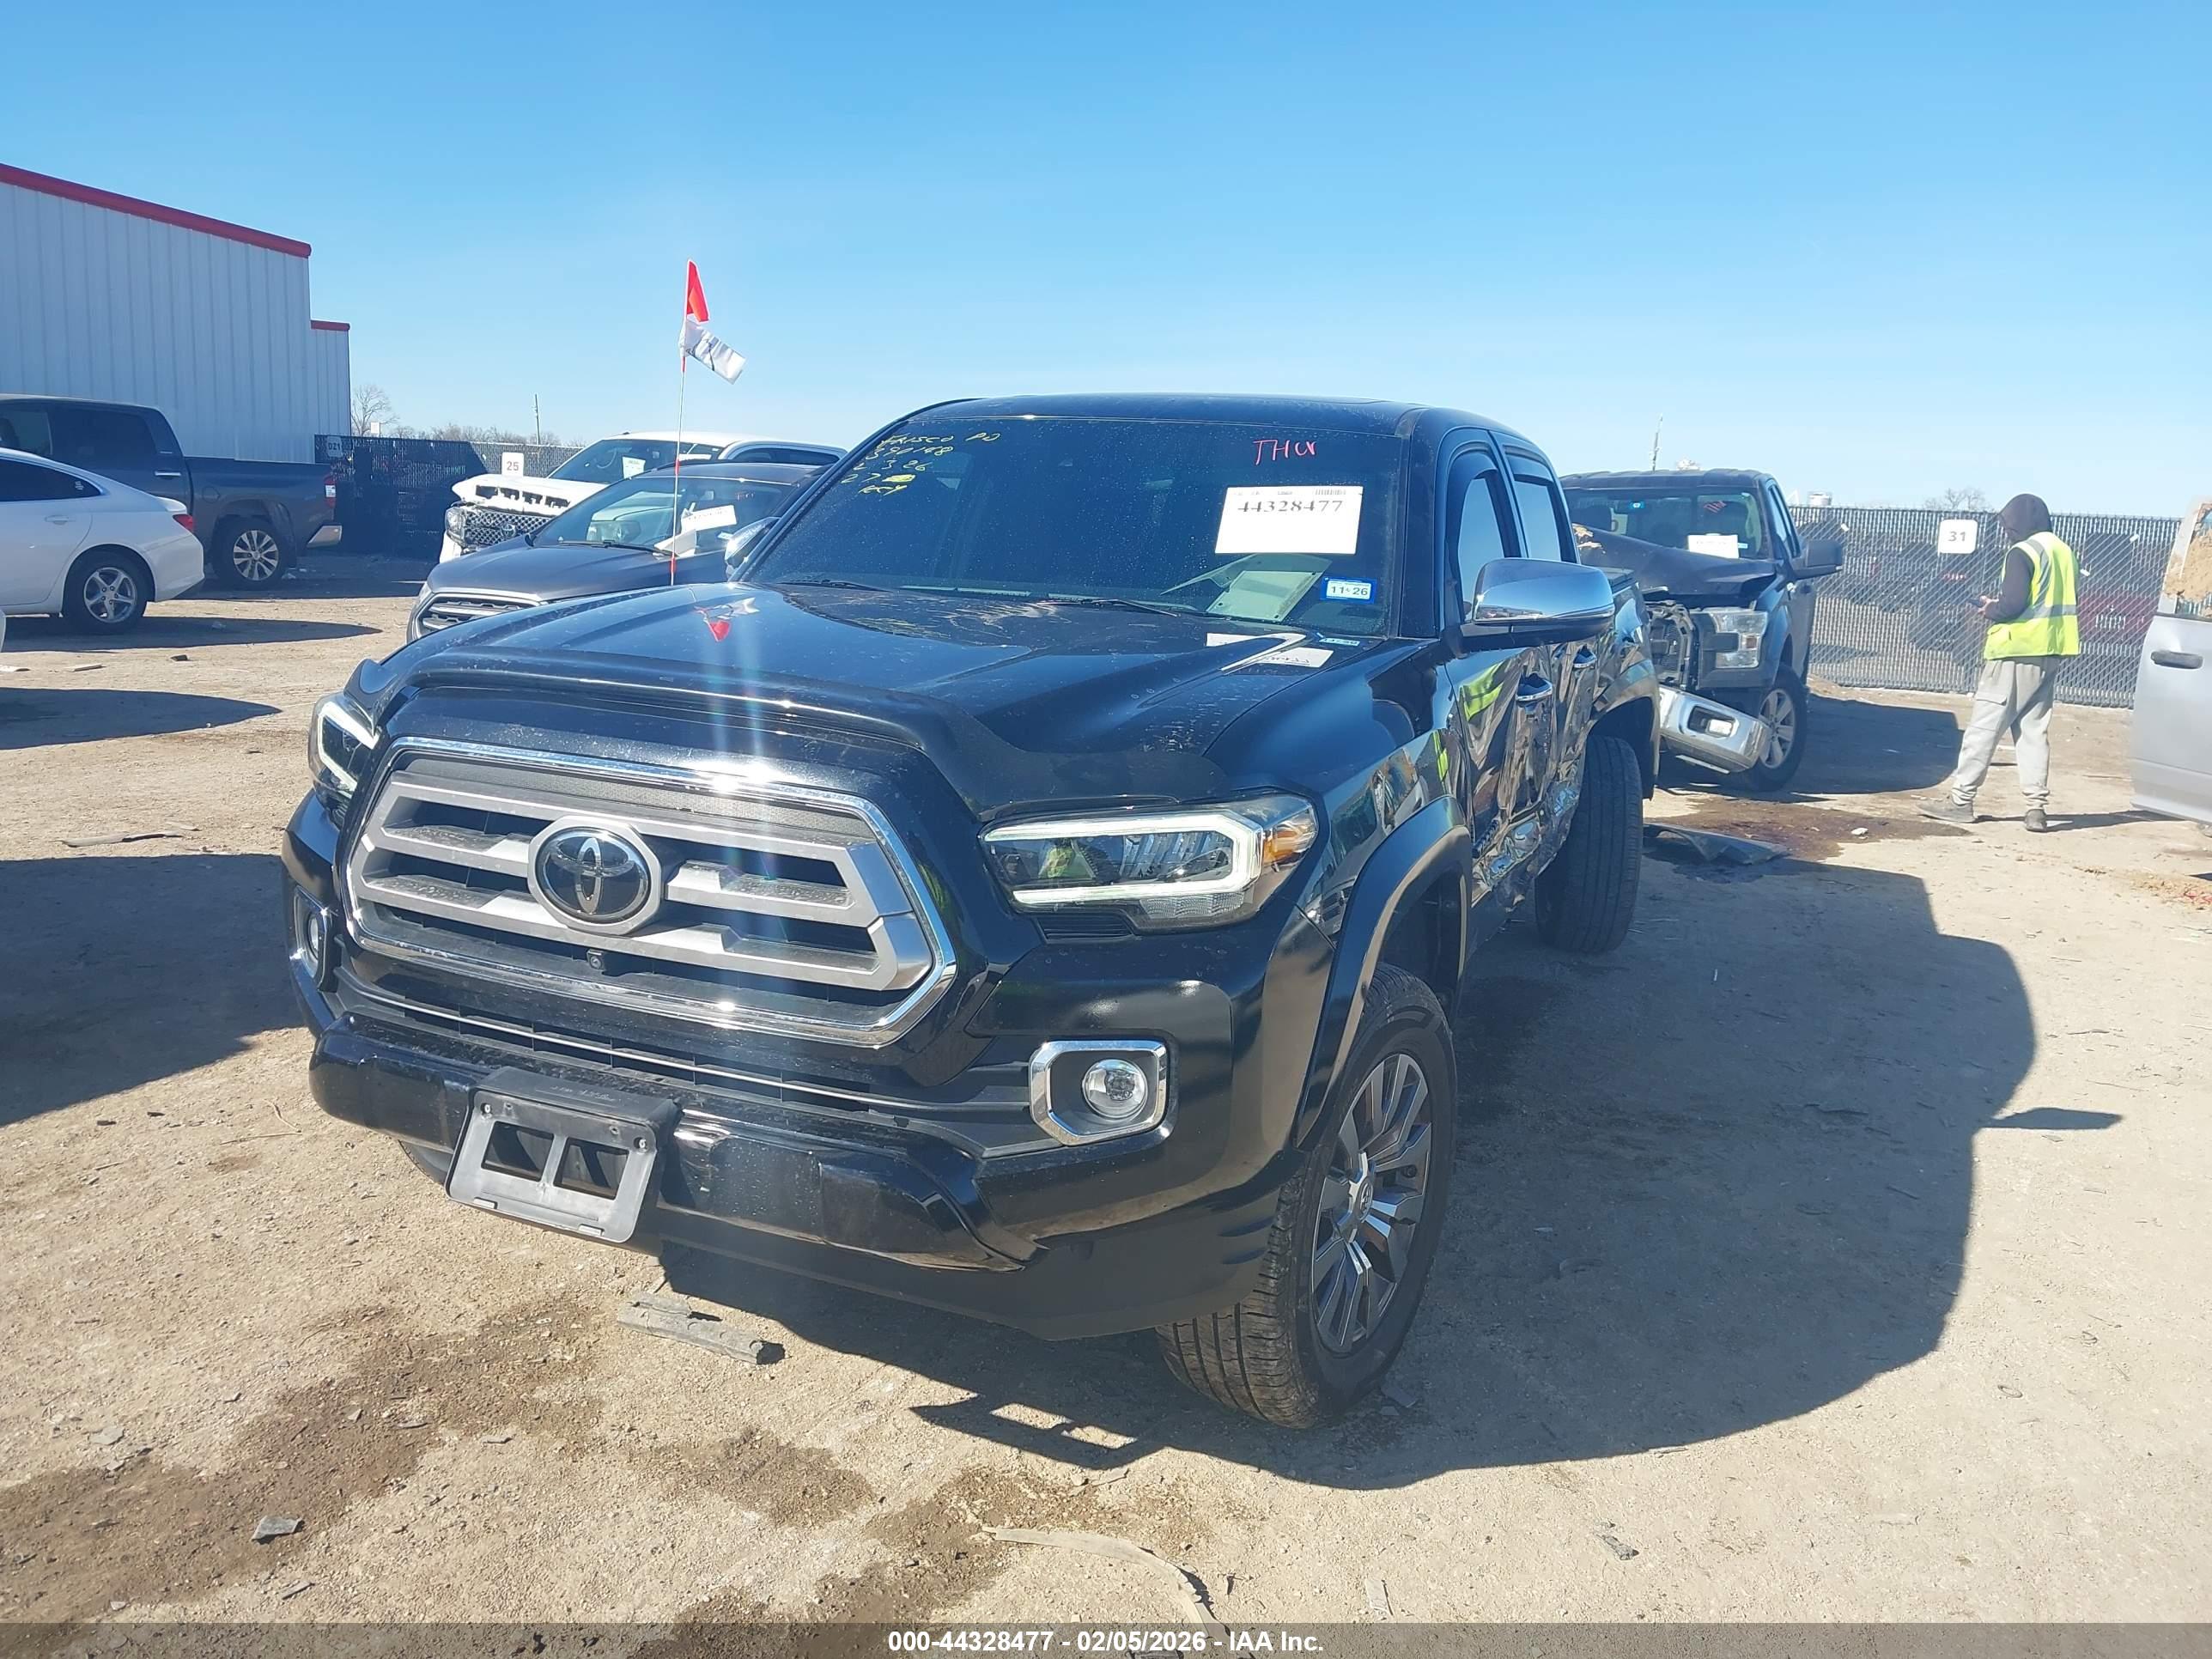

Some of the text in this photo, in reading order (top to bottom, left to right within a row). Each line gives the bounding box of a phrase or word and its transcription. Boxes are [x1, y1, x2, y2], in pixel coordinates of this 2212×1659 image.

[506, 461, 520, 471] 25
[1237, 500, 1343, 513] 44328477
[1948, 531, 1966, 542] 31
[1331, 586, 1369, 596] 11 26
